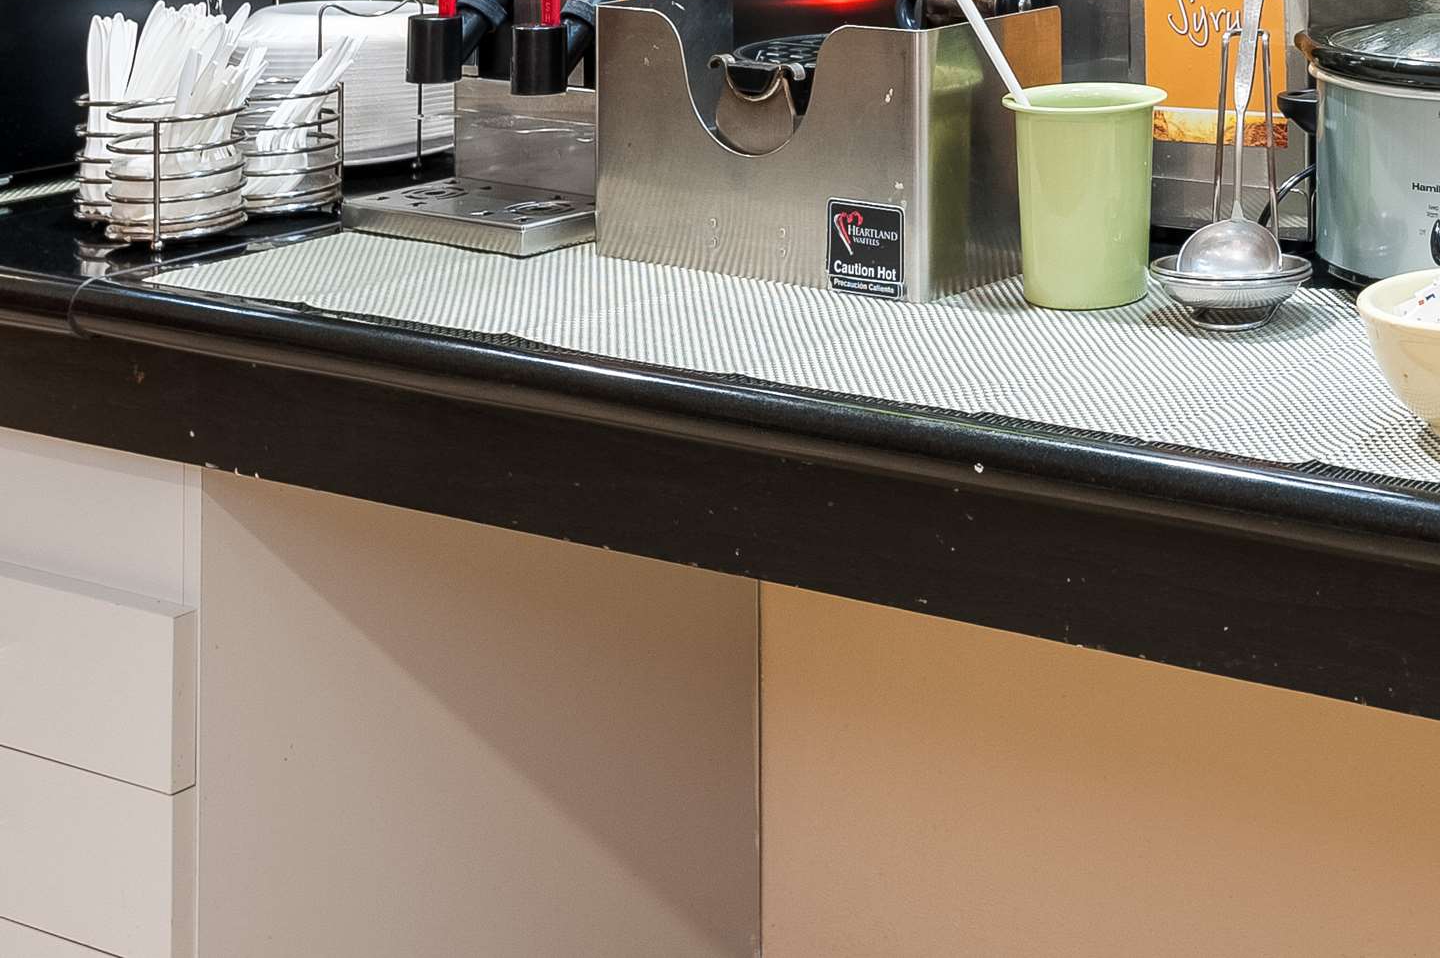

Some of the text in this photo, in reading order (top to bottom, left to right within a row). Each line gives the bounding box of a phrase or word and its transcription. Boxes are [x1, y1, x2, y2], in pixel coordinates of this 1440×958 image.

[847, 223, 899, 242] HEARTLAND
[852, 236, 881, 247] WAFFLES
[833, 259, 898, 281] Caution Hot
